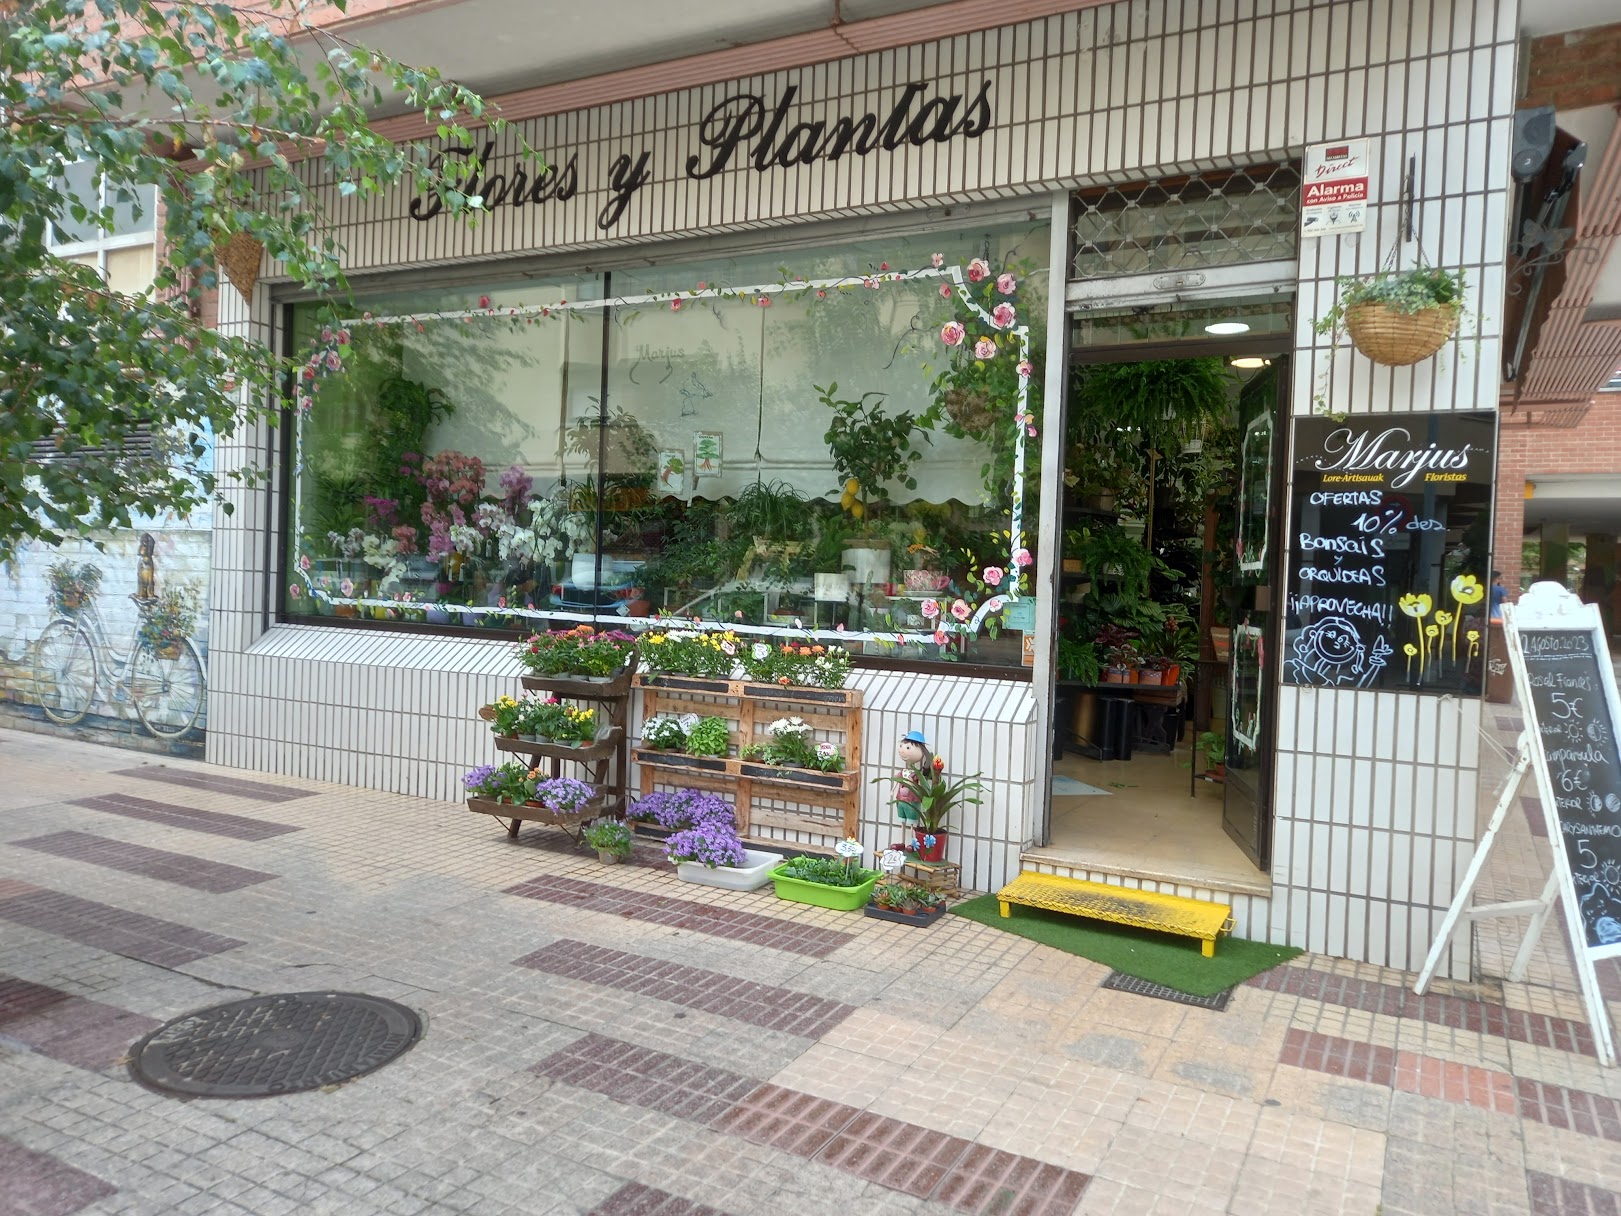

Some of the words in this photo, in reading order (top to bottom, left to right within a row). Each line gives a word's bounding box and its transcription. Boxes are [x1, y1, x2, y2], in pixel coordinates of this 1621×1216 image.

[598, 153, 652, 230] y
[686, 80, 992, 180] Plantas
[1307, 182, 1364, 198] Alarma
[1315, 428, 1470, 489] Marjus
[1323, 473, 1384, 483] Lore-Artisauak
[1425, 472, 1467, 482] Floristas
[1310, 489, 1383, 506] OFERTAS
[1351, 510, 1402, 534] 10%
[1551, 692, 1583, 718] 5€
[1562, 769, 1588, 791] 6€
[1577, 839, 1598, 868] 5
